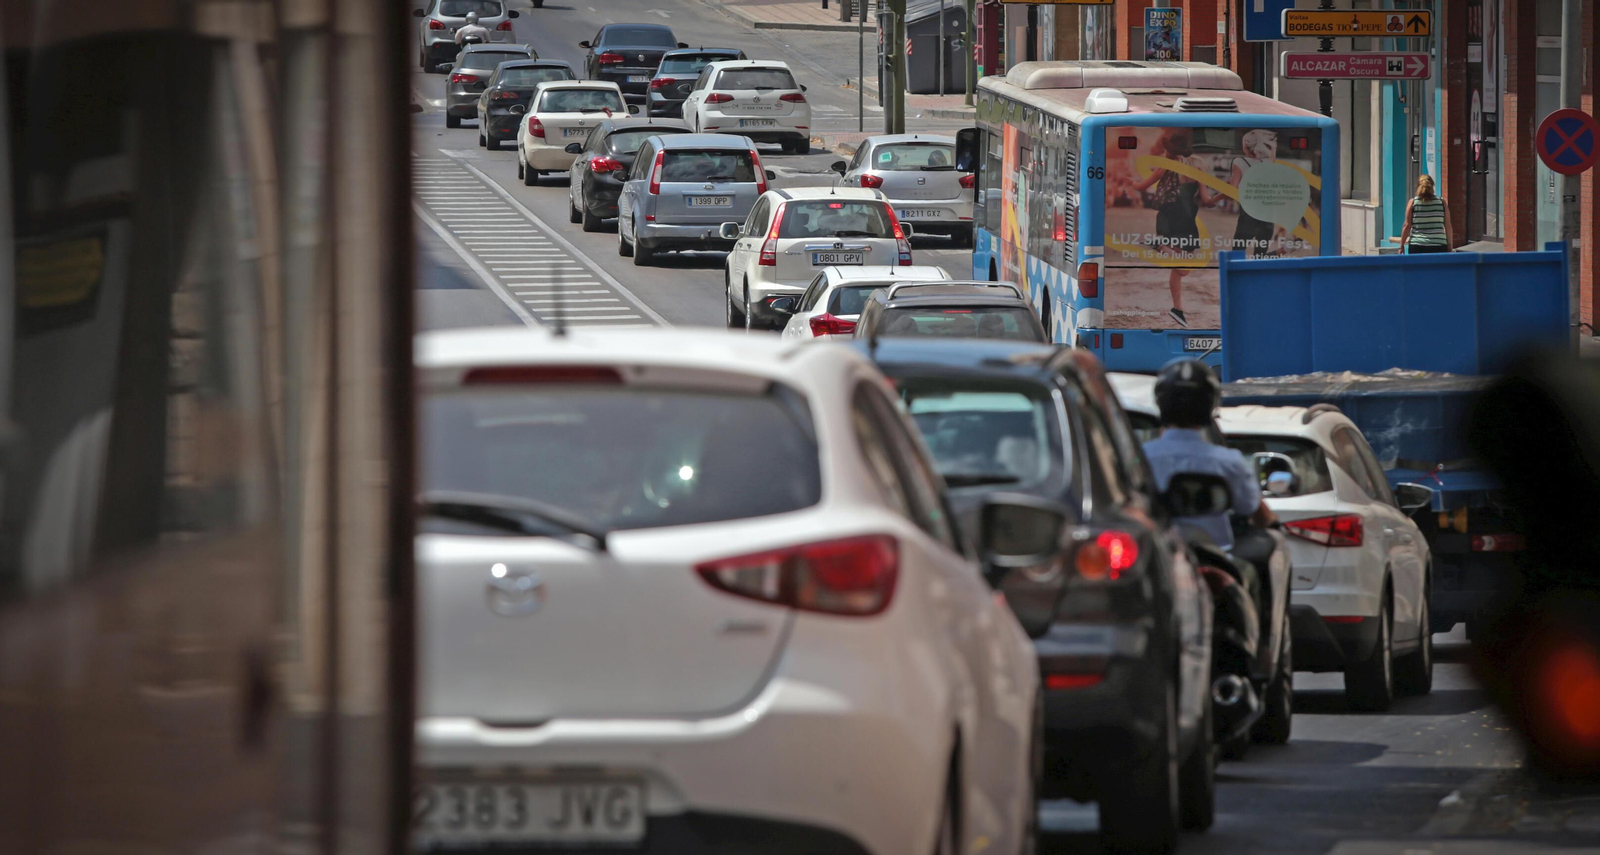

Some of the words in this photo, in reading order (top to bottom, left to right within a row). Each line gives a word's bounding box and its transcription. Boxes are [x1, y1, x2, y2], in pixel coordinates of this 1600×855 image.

[1150, 11, 1177, 19] DINO
[1150, 19, 1177, 27] EXPO
[1289, 23, 1333, 31] BODEGAS
[1361, 23, 1383, 31] PEPE
[1350, 57, 1382, 65] Cámara
[1291, 61, 1346, 71] ALCAZAR
[1350, 67, 1380, 75] Oscura
[1086, 166, 1104, 180] 66
[695, 197, 711, 205] 1399
[906, 210, 924, 218] 8211
[927, 210, 941, 218] GXZ
[1112, 233, 1139, 245] LUZ
[1144, 234, 1210, 249] Shopping
[1214, 235, 1274, 249] Summer
[819, 253, 840, 262] 0801
[843, 253, 861, 262] GPV
[1122, 250, 1139, 258] Del
[1142, 250, 1153, 259] 15
[1156, 250, 1168, 259] de
[1171, 250, 1194, 260] julio
[1196, 251, 1206, 259] al
[1106, 309, 1160, 317] luzshopping.com
[1189, 339, 1213, 349] 6407
[411, 785, 528, 830] 2383
[546, 785, 634, 830] JVG
